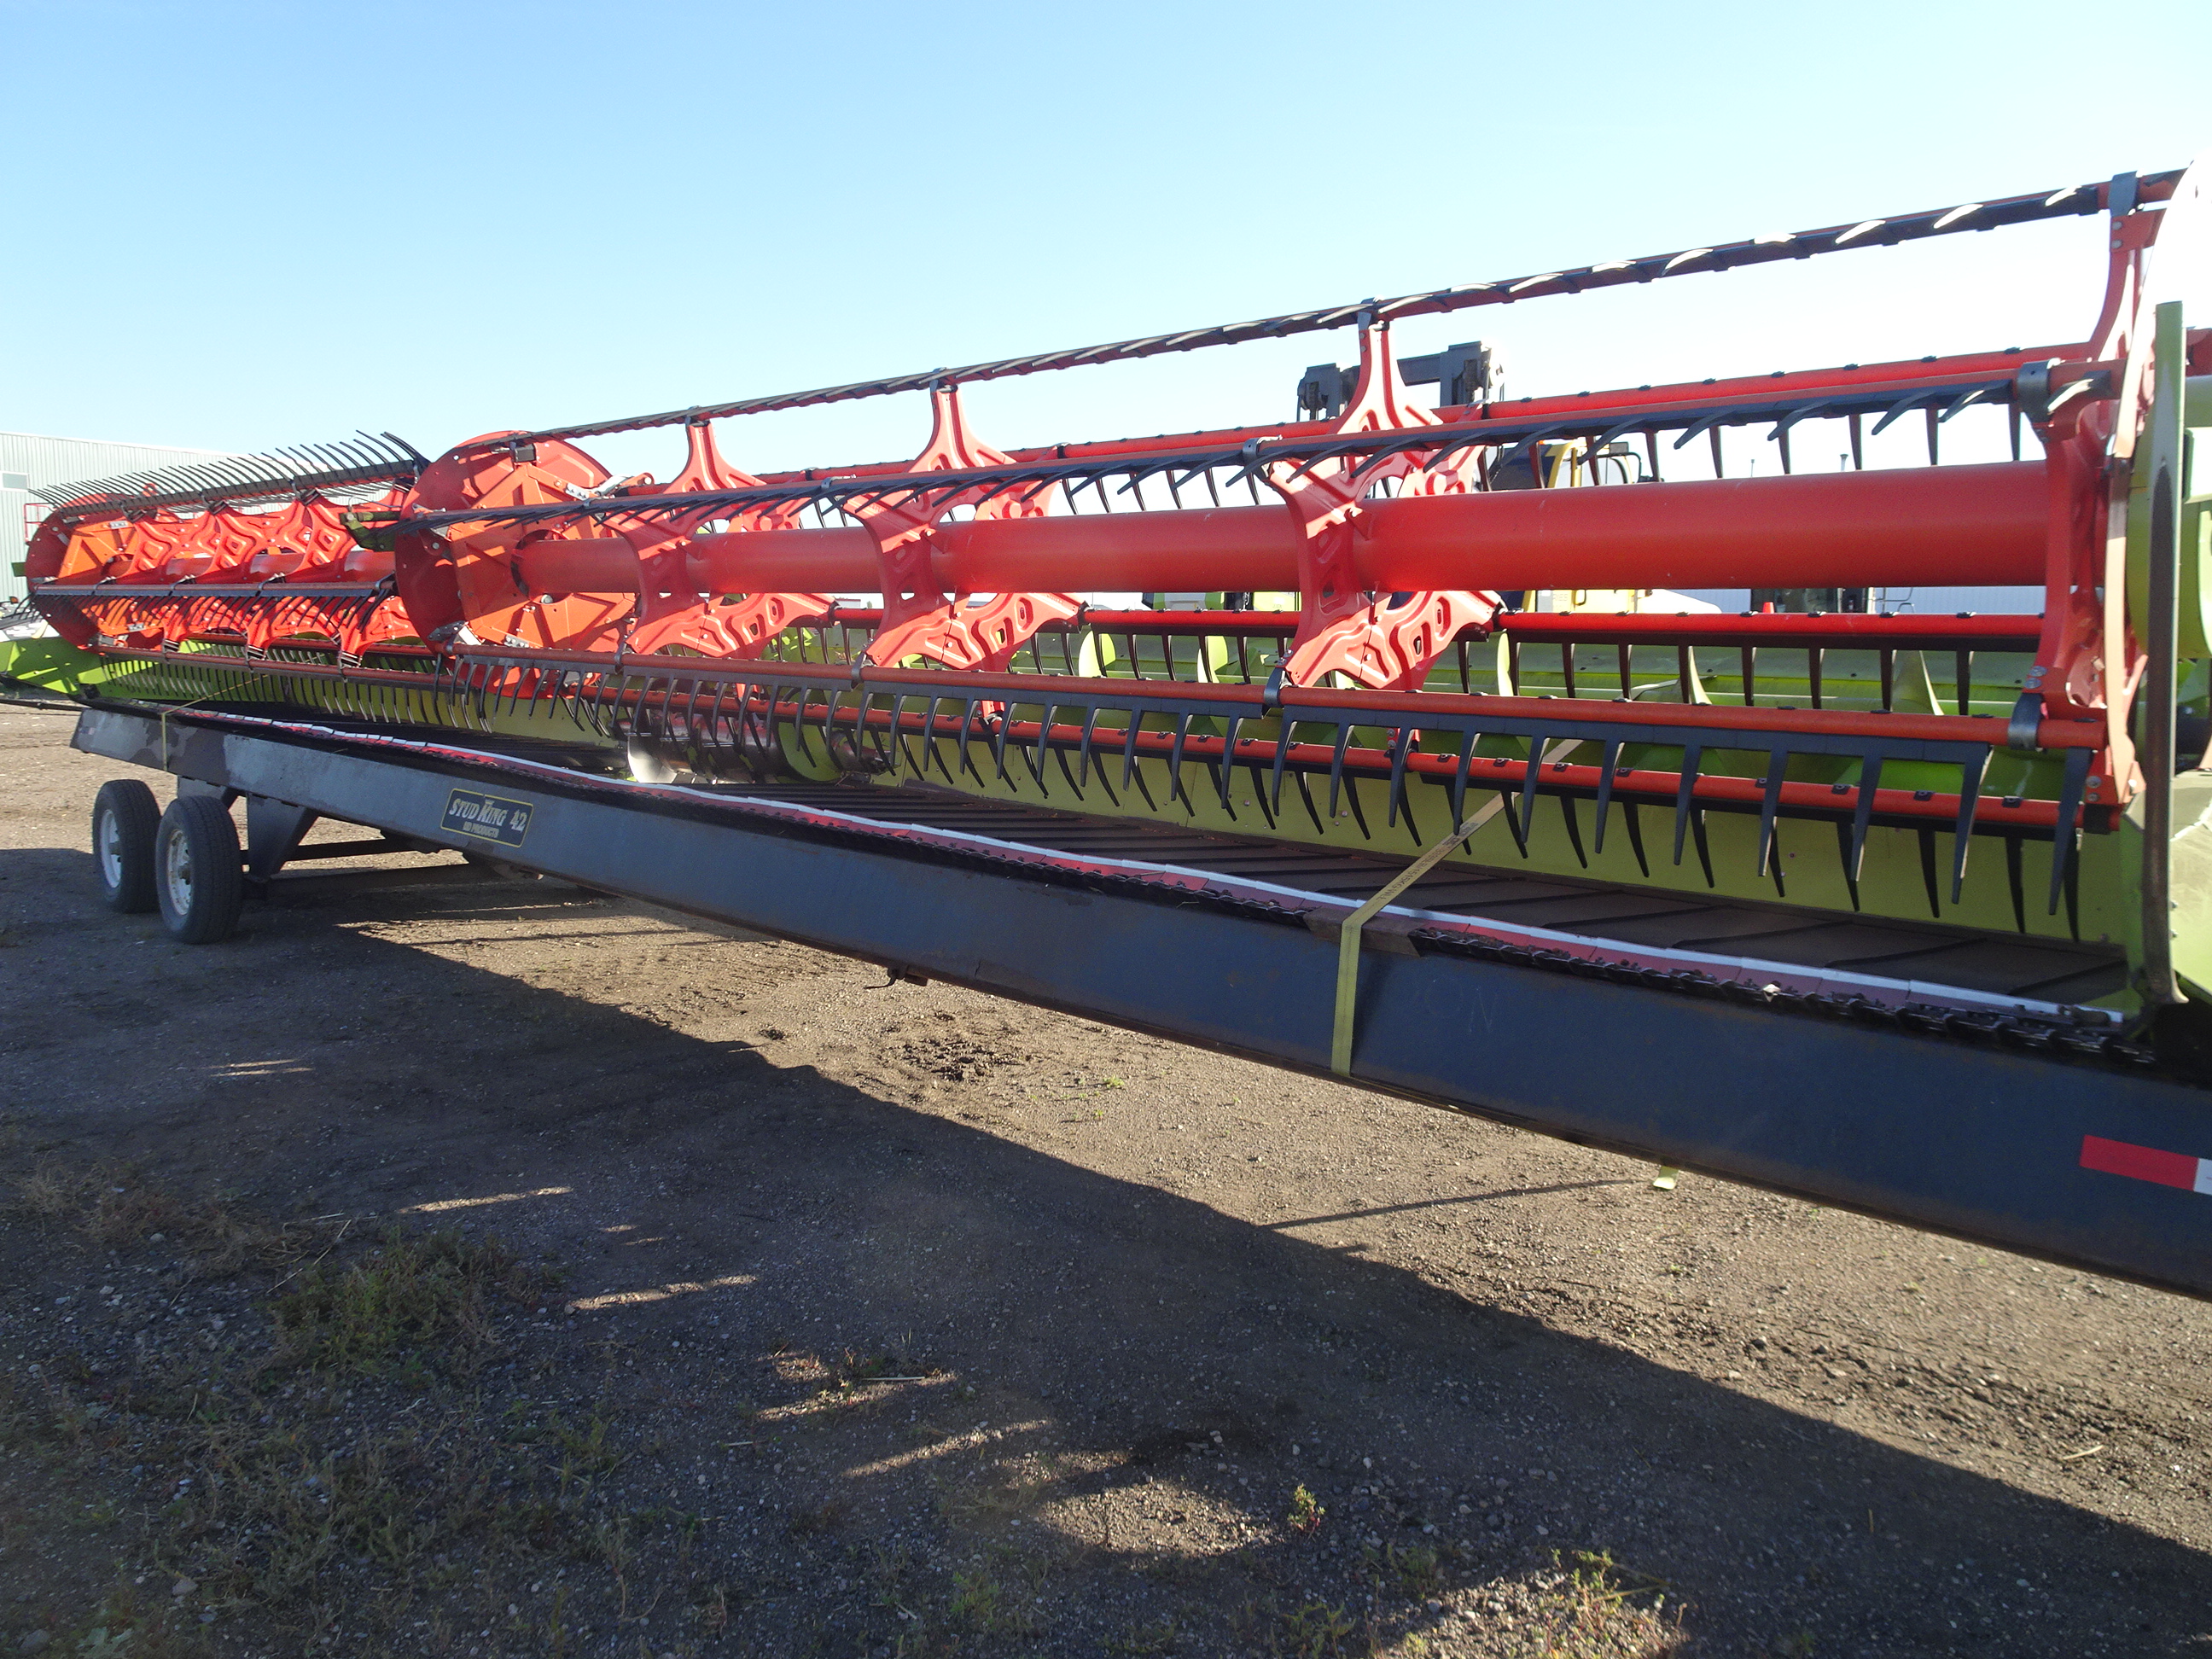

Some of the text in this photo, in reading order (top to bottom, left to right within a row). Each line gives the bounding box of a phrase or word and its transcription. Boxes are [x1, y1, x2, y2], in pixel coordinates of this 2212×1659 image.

[449, 798, 527, 833] STUD KING 42
